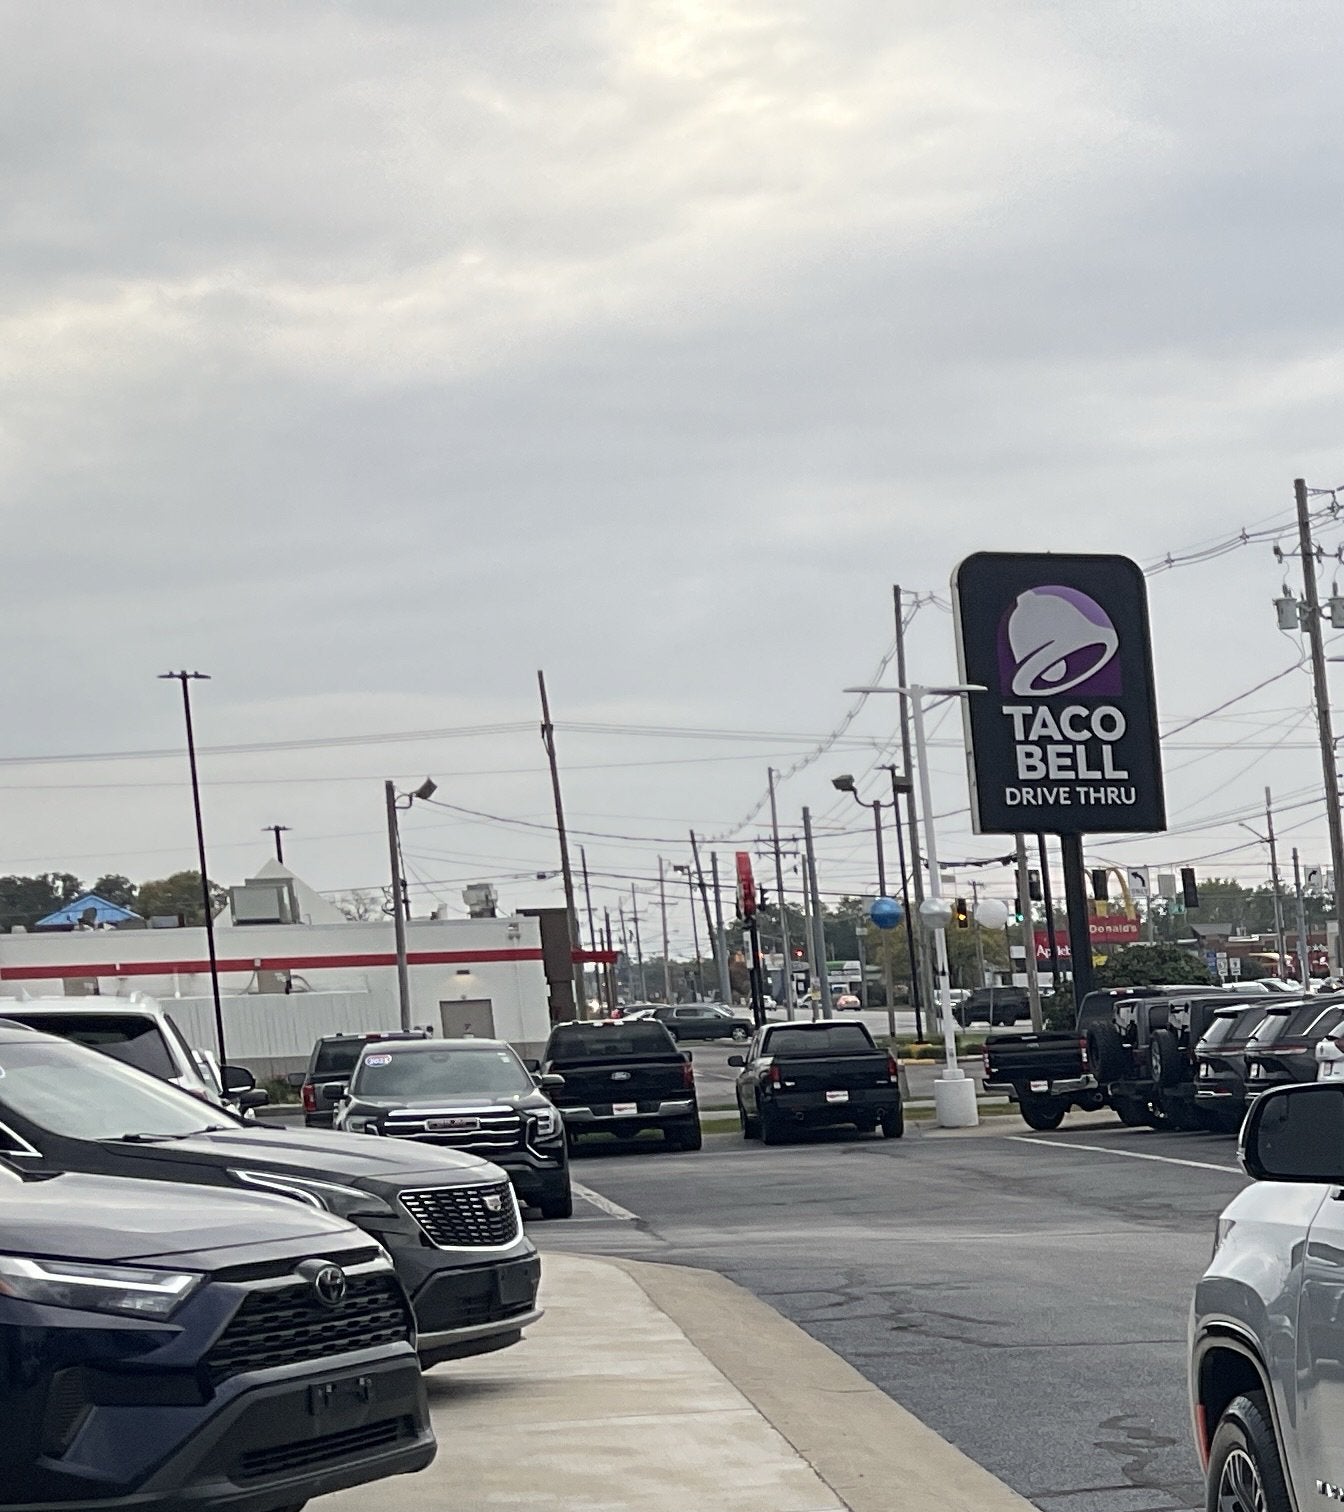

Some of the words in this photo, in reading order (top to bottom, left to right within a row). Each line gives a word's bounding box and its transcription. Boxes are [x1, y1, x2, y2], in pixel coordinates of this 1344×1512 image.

[1002, 705, 1127, 742] TACO
[1016, 744, 1129, 780] BELL
[1005, 786, 1072, 805] DRIVE
[1075, 786, 1136, 805] THRU
[1089, 924, 1138, 934] Donald's
